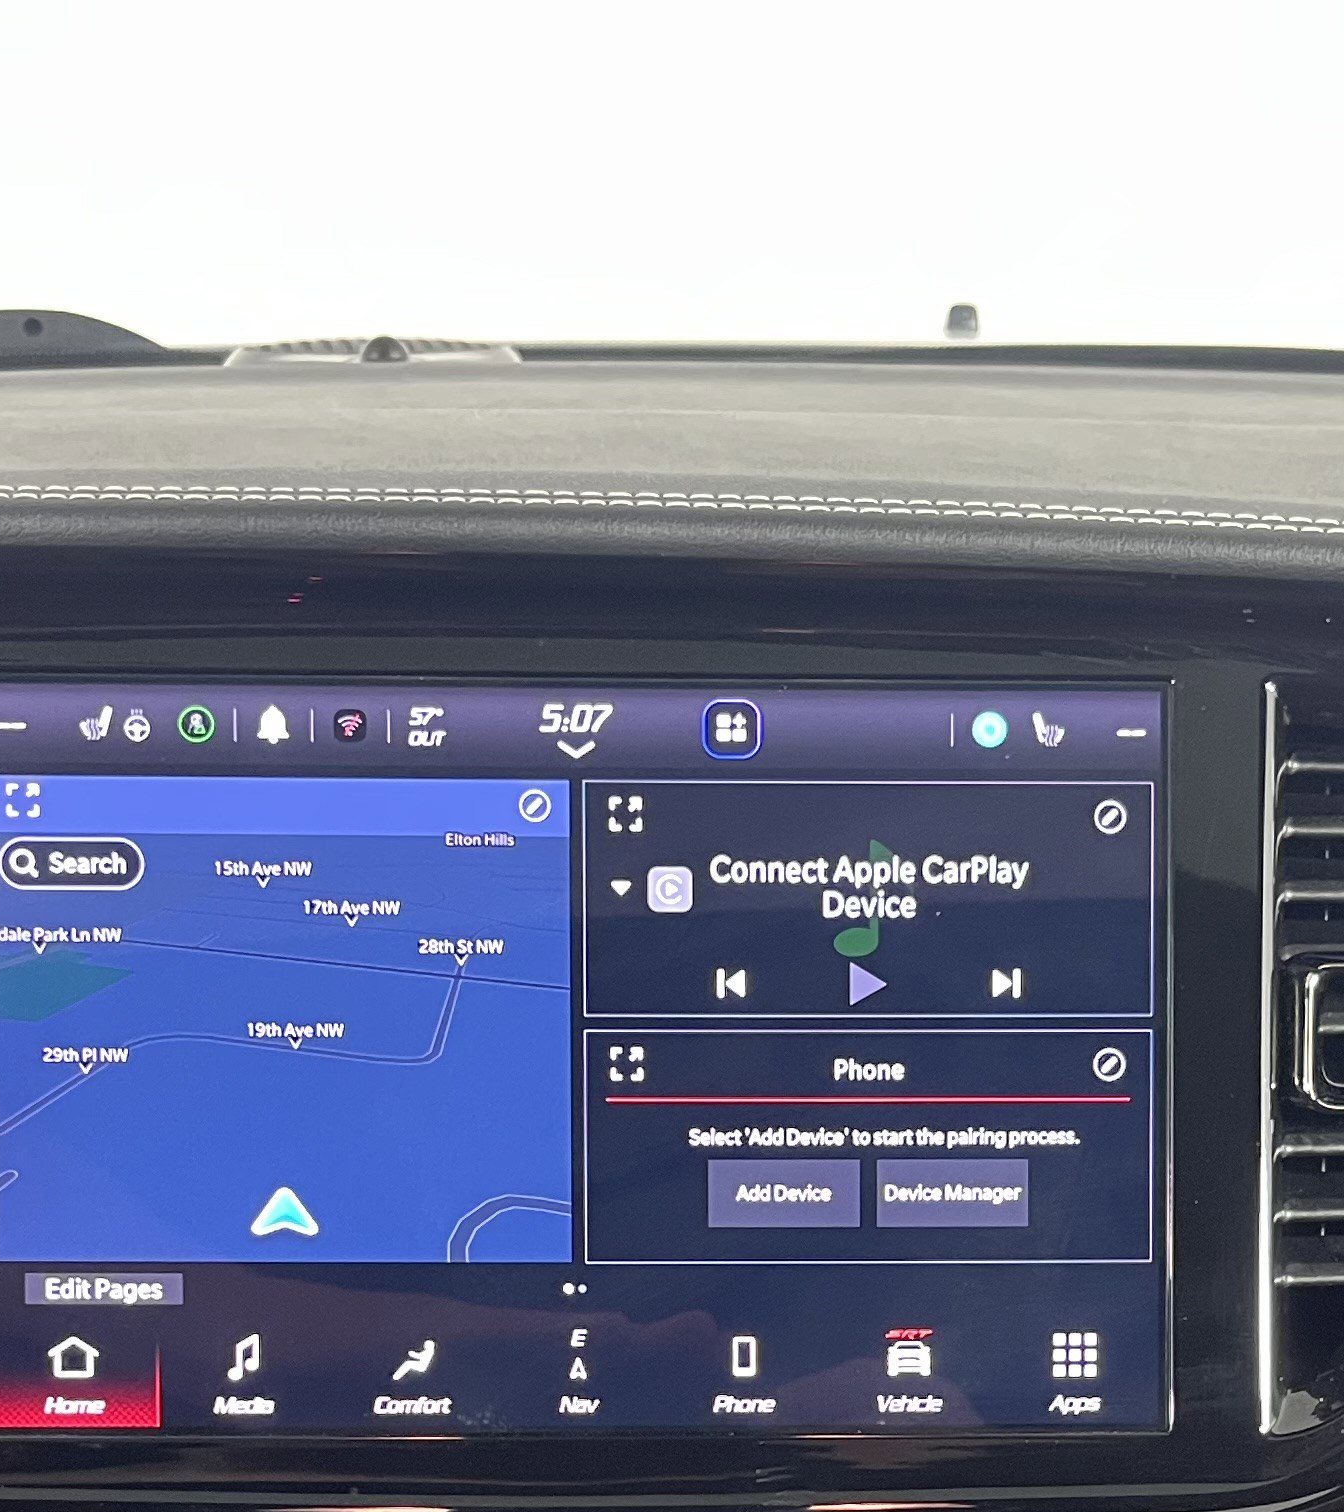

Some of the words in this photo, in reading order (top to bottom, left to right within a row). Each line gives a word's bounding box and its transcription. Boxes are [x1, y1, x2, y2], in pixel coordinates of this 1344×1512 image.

[539, 703, 614, 733] 5:07
[408, 730, 447, 747] OUT
[445, 833, 481, 847] Elton
[485, 833, 515, 847] Hills
[49, 852, 128, 875] Search
[215, 861, 249, 876] 15th
[252, 861, 281, 876] Ave
[284, 861, 313, 876] NW
[709, 854, 829, 884] Connect
[833, 855, 916, 888] Apple
[921, 854, 1030, 889] CarPlay
[304, 900, 338, 915] 17th
[341, 900, 369, 915] Ave
[373, 900, 400, 915] NW
[822, 890, 916, 918] Device
[33, 927, 69, 942] Park
[71, 927, 91, 942] Ln
[93, 927, 122, 942] NW
[418, 939, 455, 954] 28th
[456, 939, 474, 954] St
[476, 939, 504, 954] NW
[247, 1022, 283, 1038] 19th
[284, 1022, 314, 1038] Ave
[316, 1022, 345, 1038] NW
[42, 1047, 80, 1063] 29th
[100, 1047, 129, 1063] NW
[833, 1058, 905, 1082] Phone
[688, 1127, 743, 1146] Select
[745, 1127, 784, 1146] 'Add
[786, 1127, 850, 1146] Device'
[852, 1129, 871, 1146] to
[872, 1129, 915, 1146] start
[917, 1127, 945, 1146] the
[946, 1127, 1006, 1149] pairing
[1008, 1130, 1081, 1149] process.
[735, 1183, 773, 1202] Add
[774, 1183, 832, 1202] Device
[883, 1183, 943, 1202] Device
[944, 1183, 1022, 1205] Manager
[44, 1276, 91, 1300] Edit
[94, 1278, 164, 1304] Pages
[44, 1396, 107, 1415] Home
[213, 1396, 276, 1415] Media
[373, 1396, 452, 1415] Comfort
[558, 1395, 601, 1414] Nav
[712, 1394, 777, 1414] Phone
[876, 1394, 944, 1413] Vehicle
[1048, 1394, 1102, 1415] Apps
